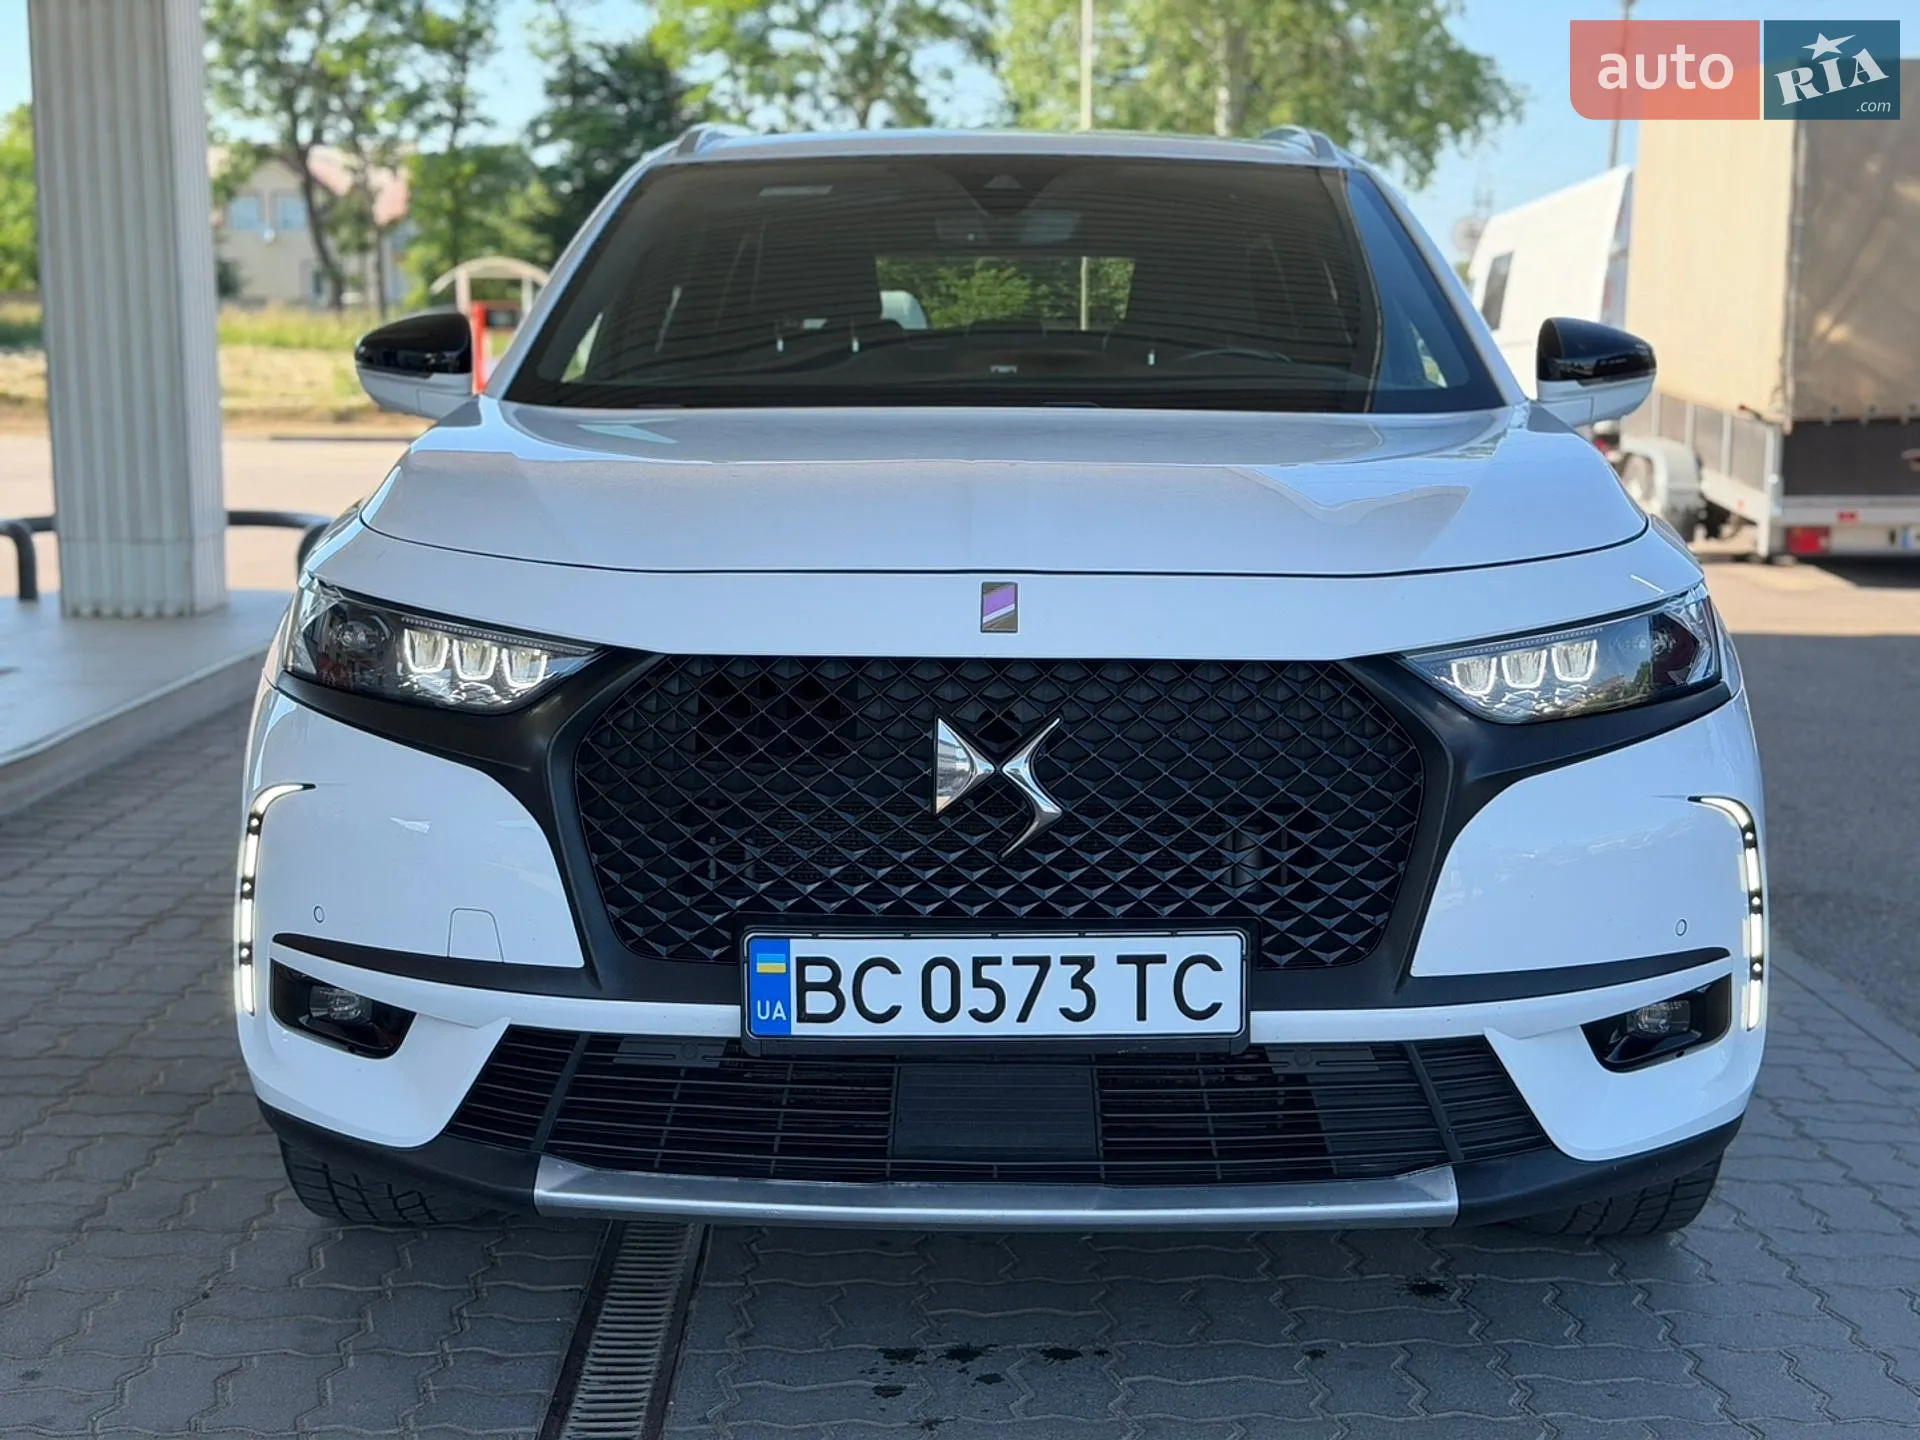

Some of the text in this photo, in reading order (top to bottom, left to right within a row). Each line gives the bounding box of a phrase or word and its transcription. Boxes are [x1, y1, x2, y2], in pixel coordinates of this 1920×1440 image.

[757, 1000, 787, 1021] UA
[795, 953, 1224, 1024] BC 0573 TC
